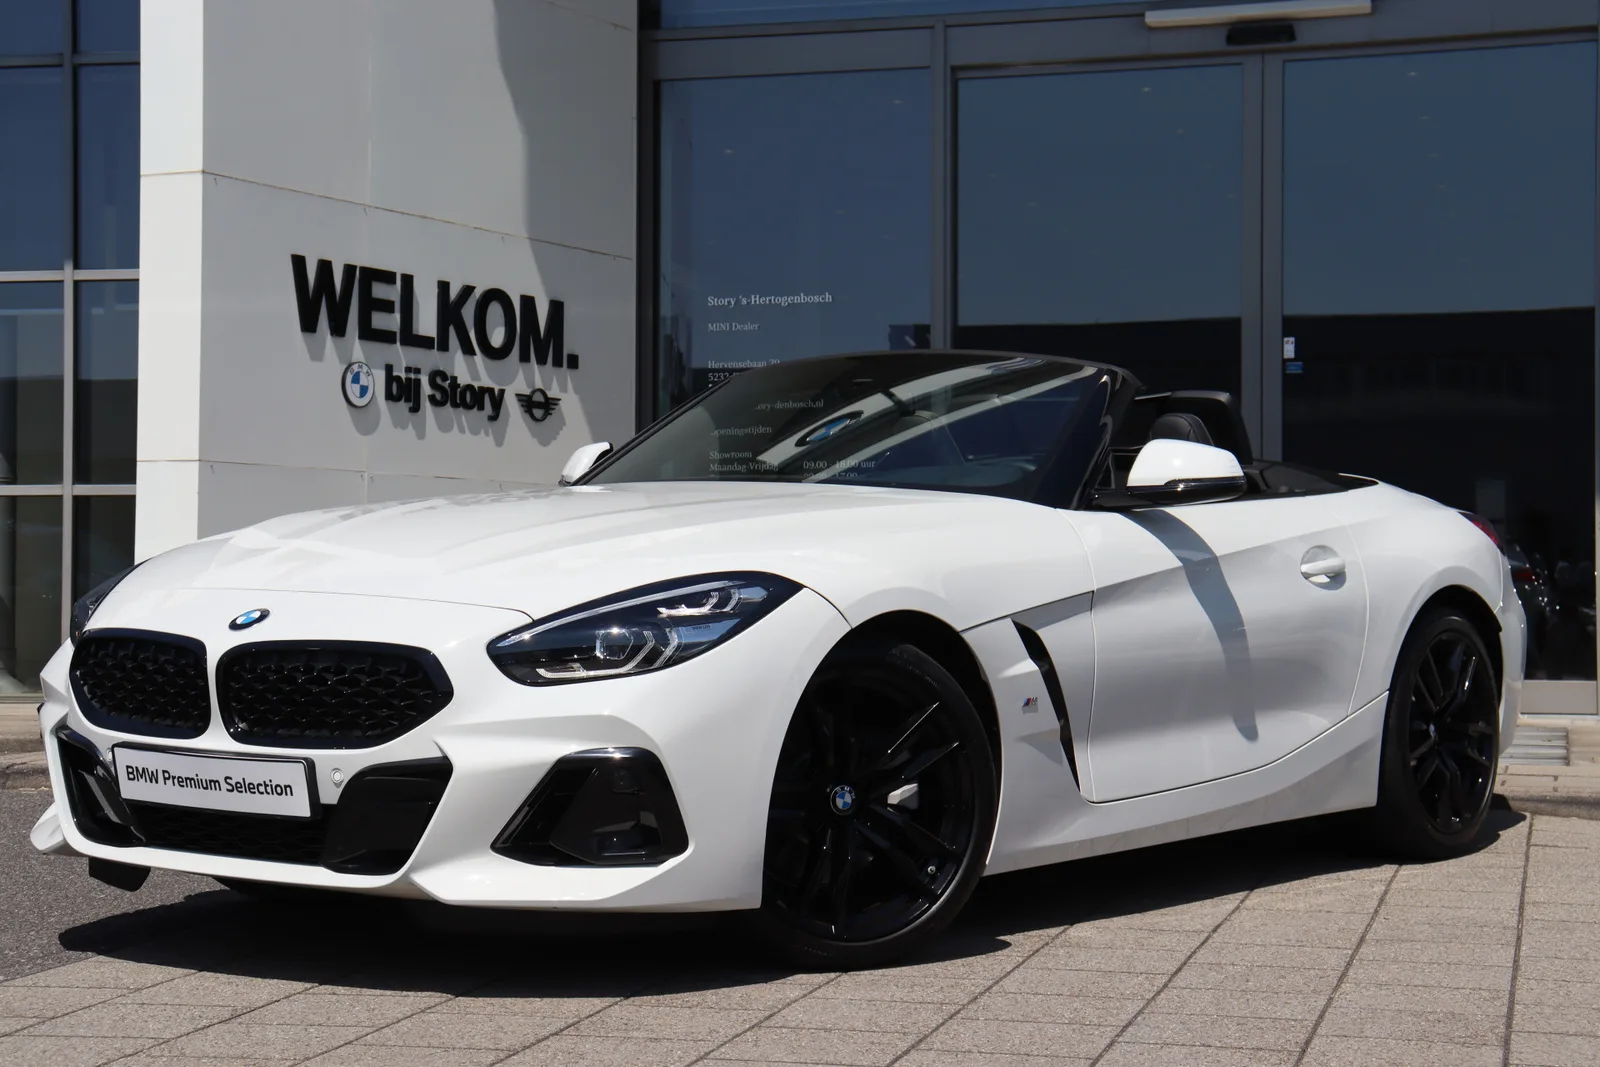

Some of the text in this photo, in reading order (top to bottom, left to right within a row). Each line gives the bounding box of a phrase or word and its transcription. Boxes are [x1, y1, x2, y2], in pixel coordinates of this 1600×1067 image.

[707, 295, 736, 308] Story
[291, 254, 579, 369] WELKOM.
[708, 321, 759, 332] MINI Dealer
[384, 363, 505, 421] bij Story
[755, 399, 824, 411] ory-denbosch.nl
[709, 450, 752, 460] Showroom
[803, 460, 827, 469] 09.00
[861, 460, 876, 468] uur
[125, 764, 294, 797] BMW Premium Selection
